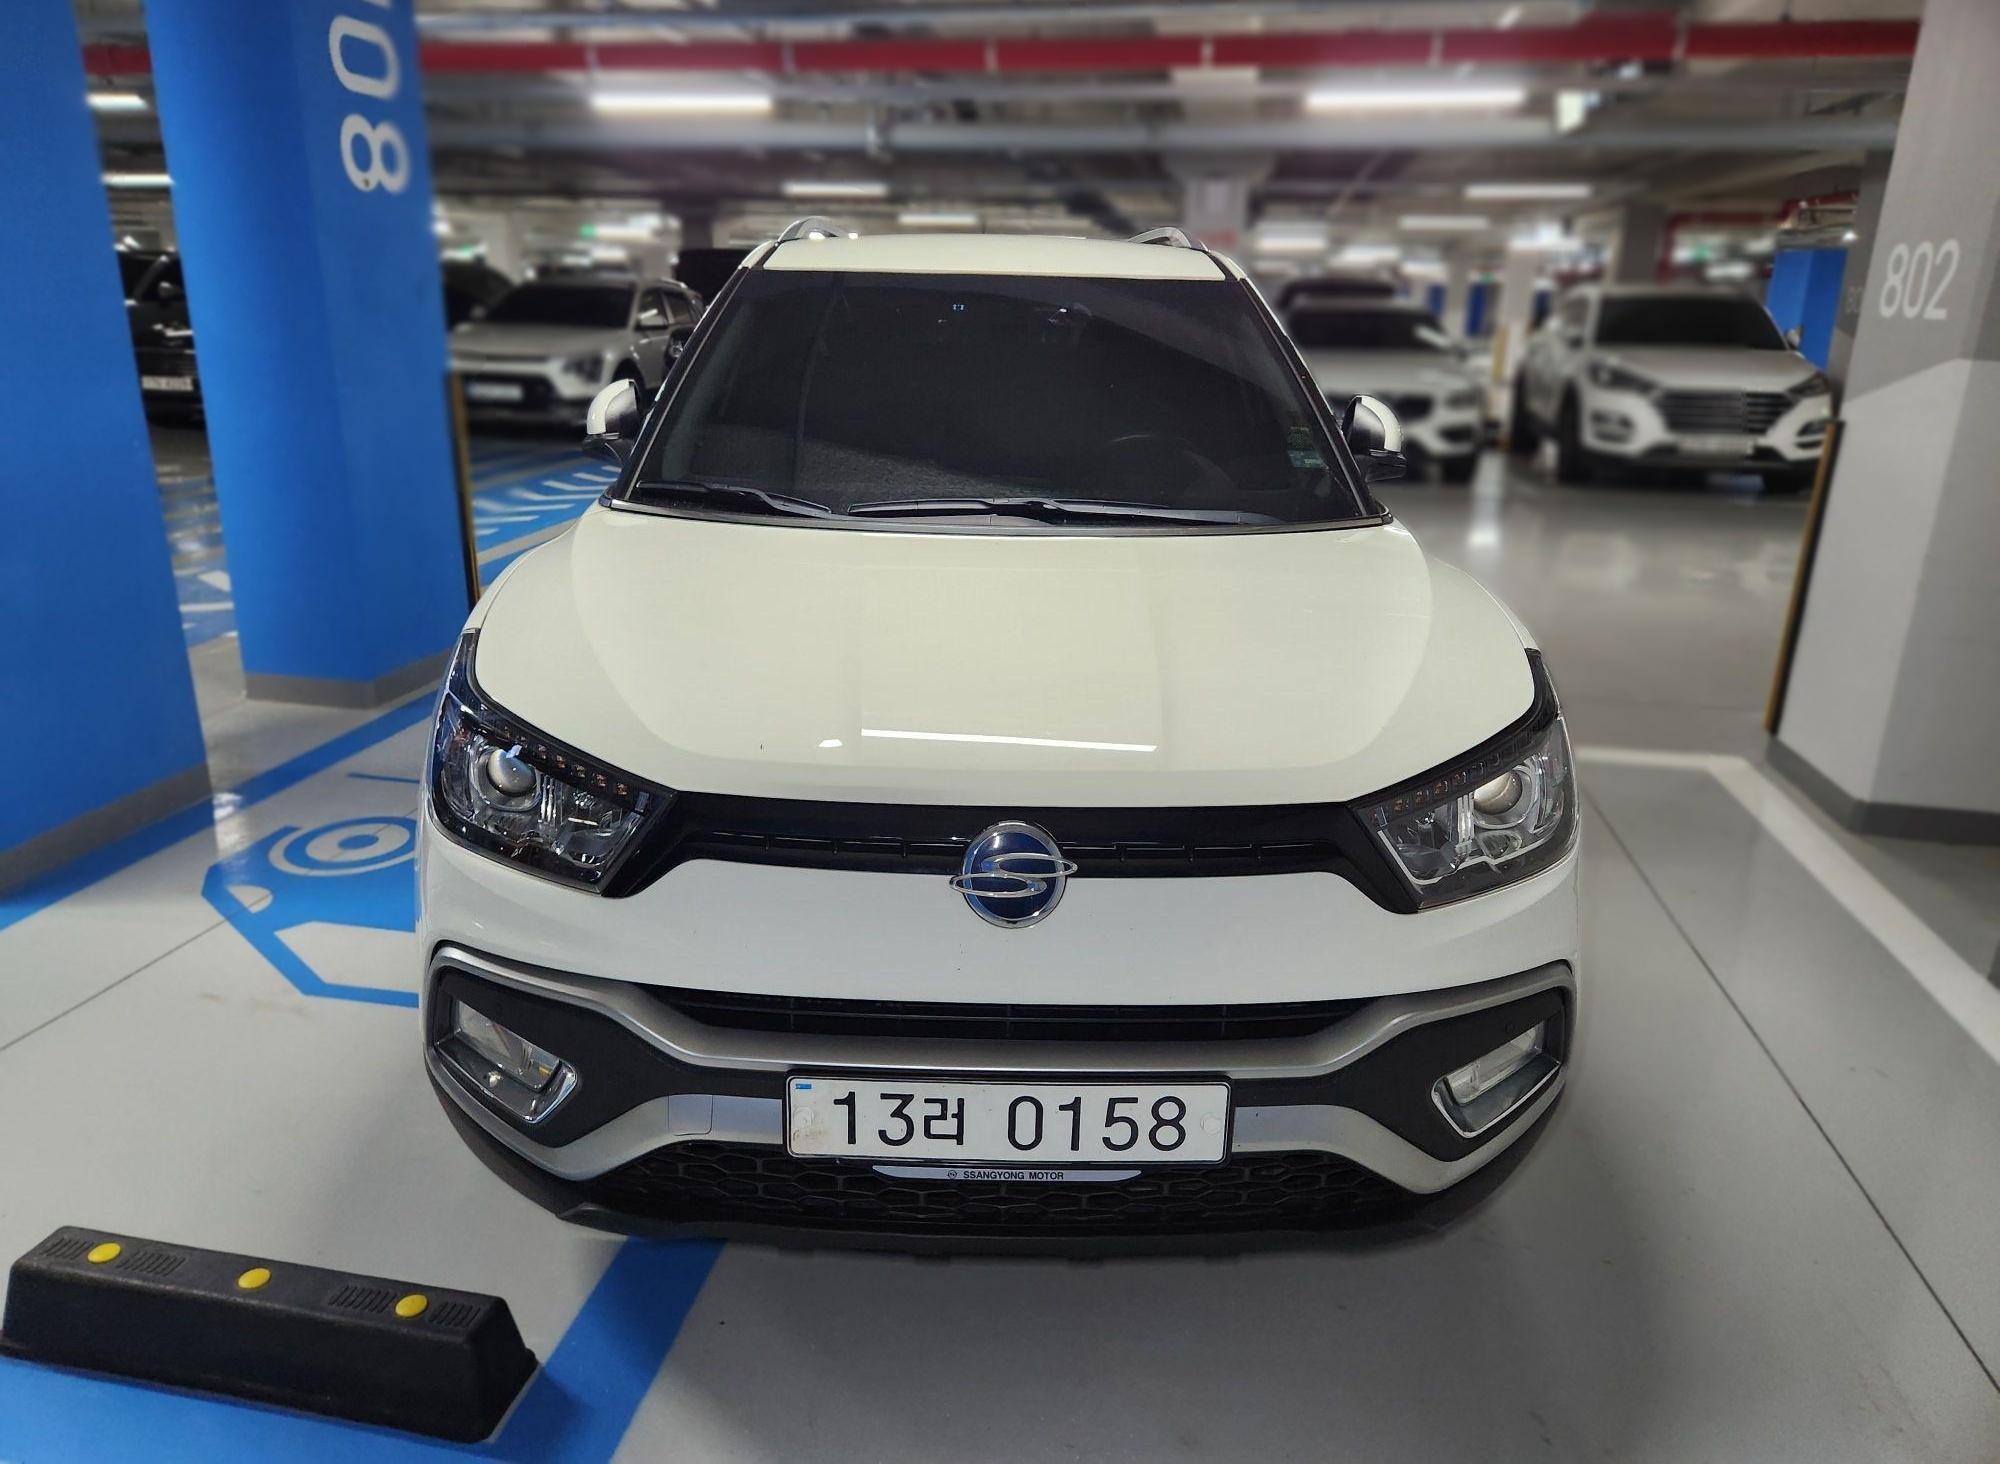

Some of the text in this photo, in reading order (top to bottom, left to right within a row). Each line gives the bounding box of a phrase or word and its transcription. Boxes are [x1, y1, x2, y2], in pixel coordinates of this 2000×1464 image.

[329, 0, 410, 194] 80
[1880, 239, 1959, 319] 802
[833, 1091, 1187, 1151] 13러 0158
[963, 1170, 1064, 1180] SSANGYONG MOTOR
